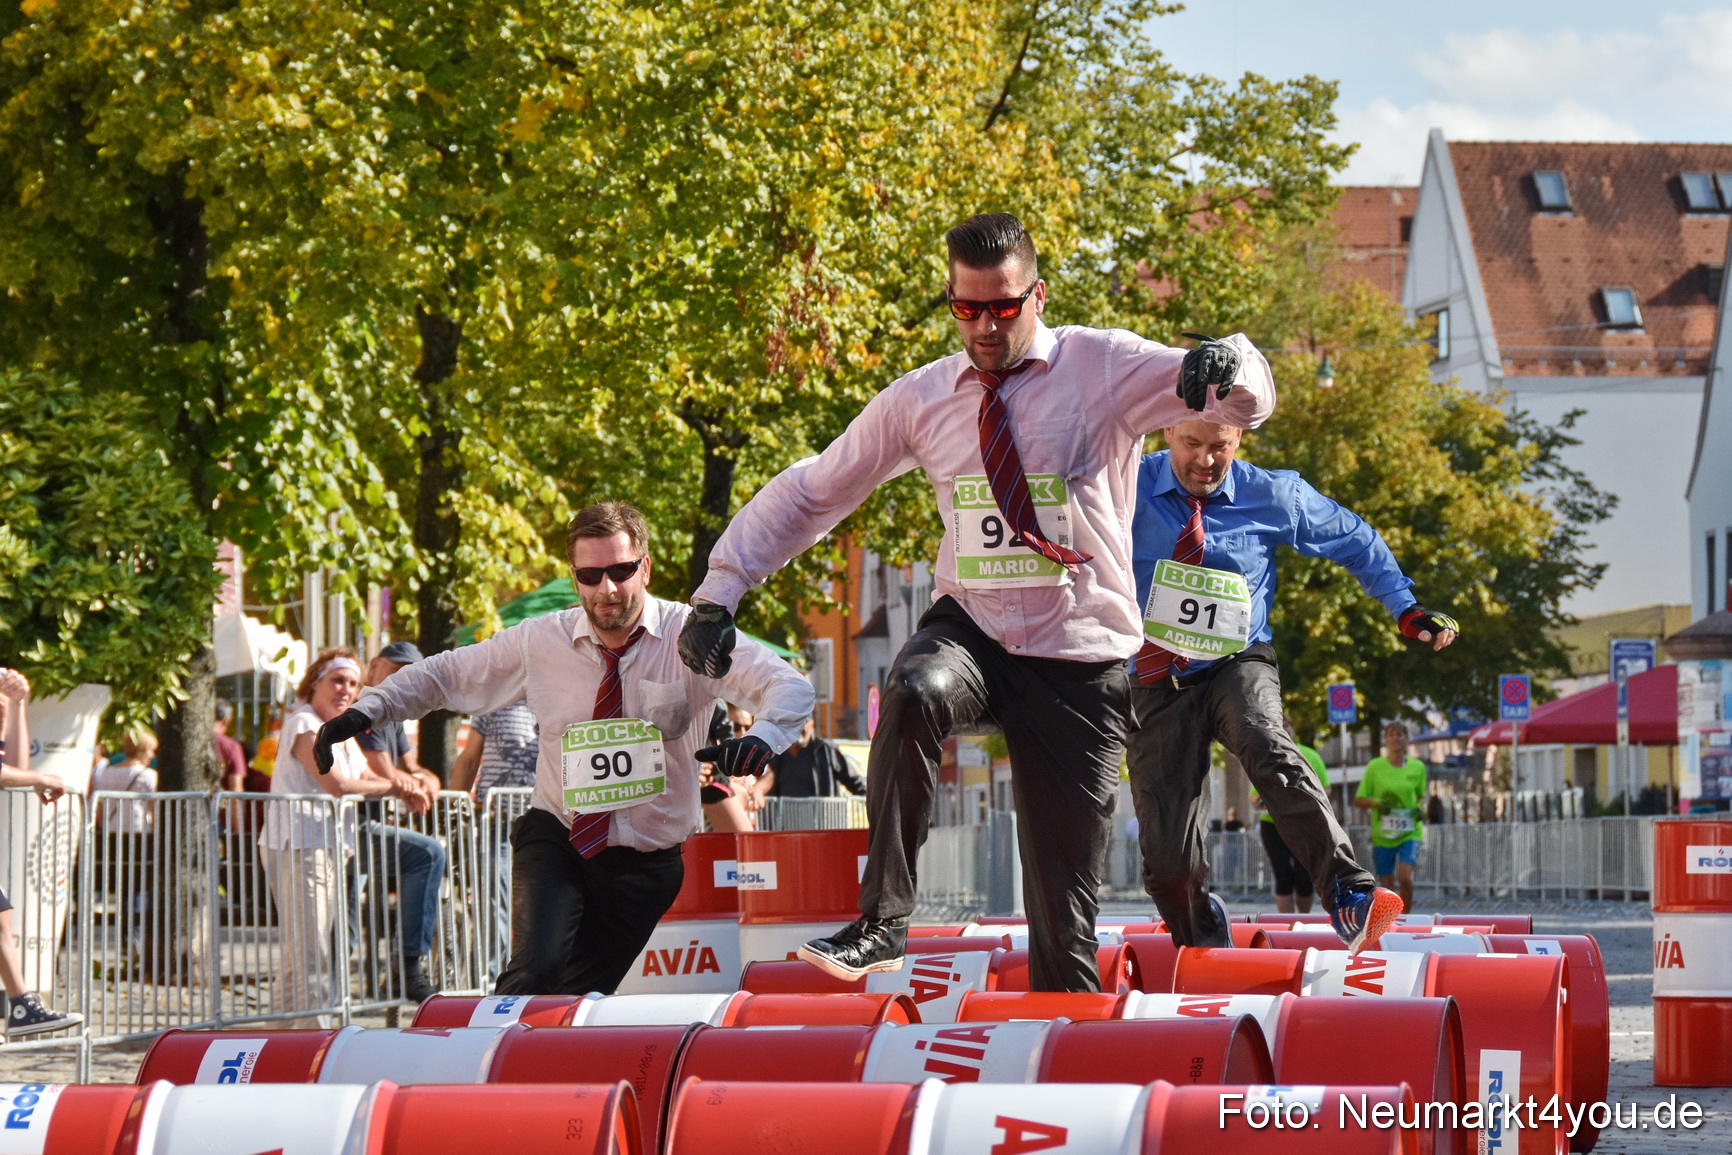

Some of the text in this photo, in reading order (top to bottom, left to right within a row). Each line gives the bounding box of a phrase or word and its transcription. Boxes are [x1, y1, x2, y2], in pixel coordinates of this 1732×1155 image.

[978, 559, 1039, 575] MARIO
[1161, 563, 1246, 600] BOCK
[1178, 598, 1218, 630] 91
[1163, 629, 1223, 652] ADRIAN
[1503, 705, 1527, 717] TAXI
[568, 720, 653, 749] BOCK
[590, 750, 632, 781] 90
[574, 782, 654, 804] MATTHIAS
[240, 1051, 258, 1084] nergie
[566, 1117, 584, 1142] 323
